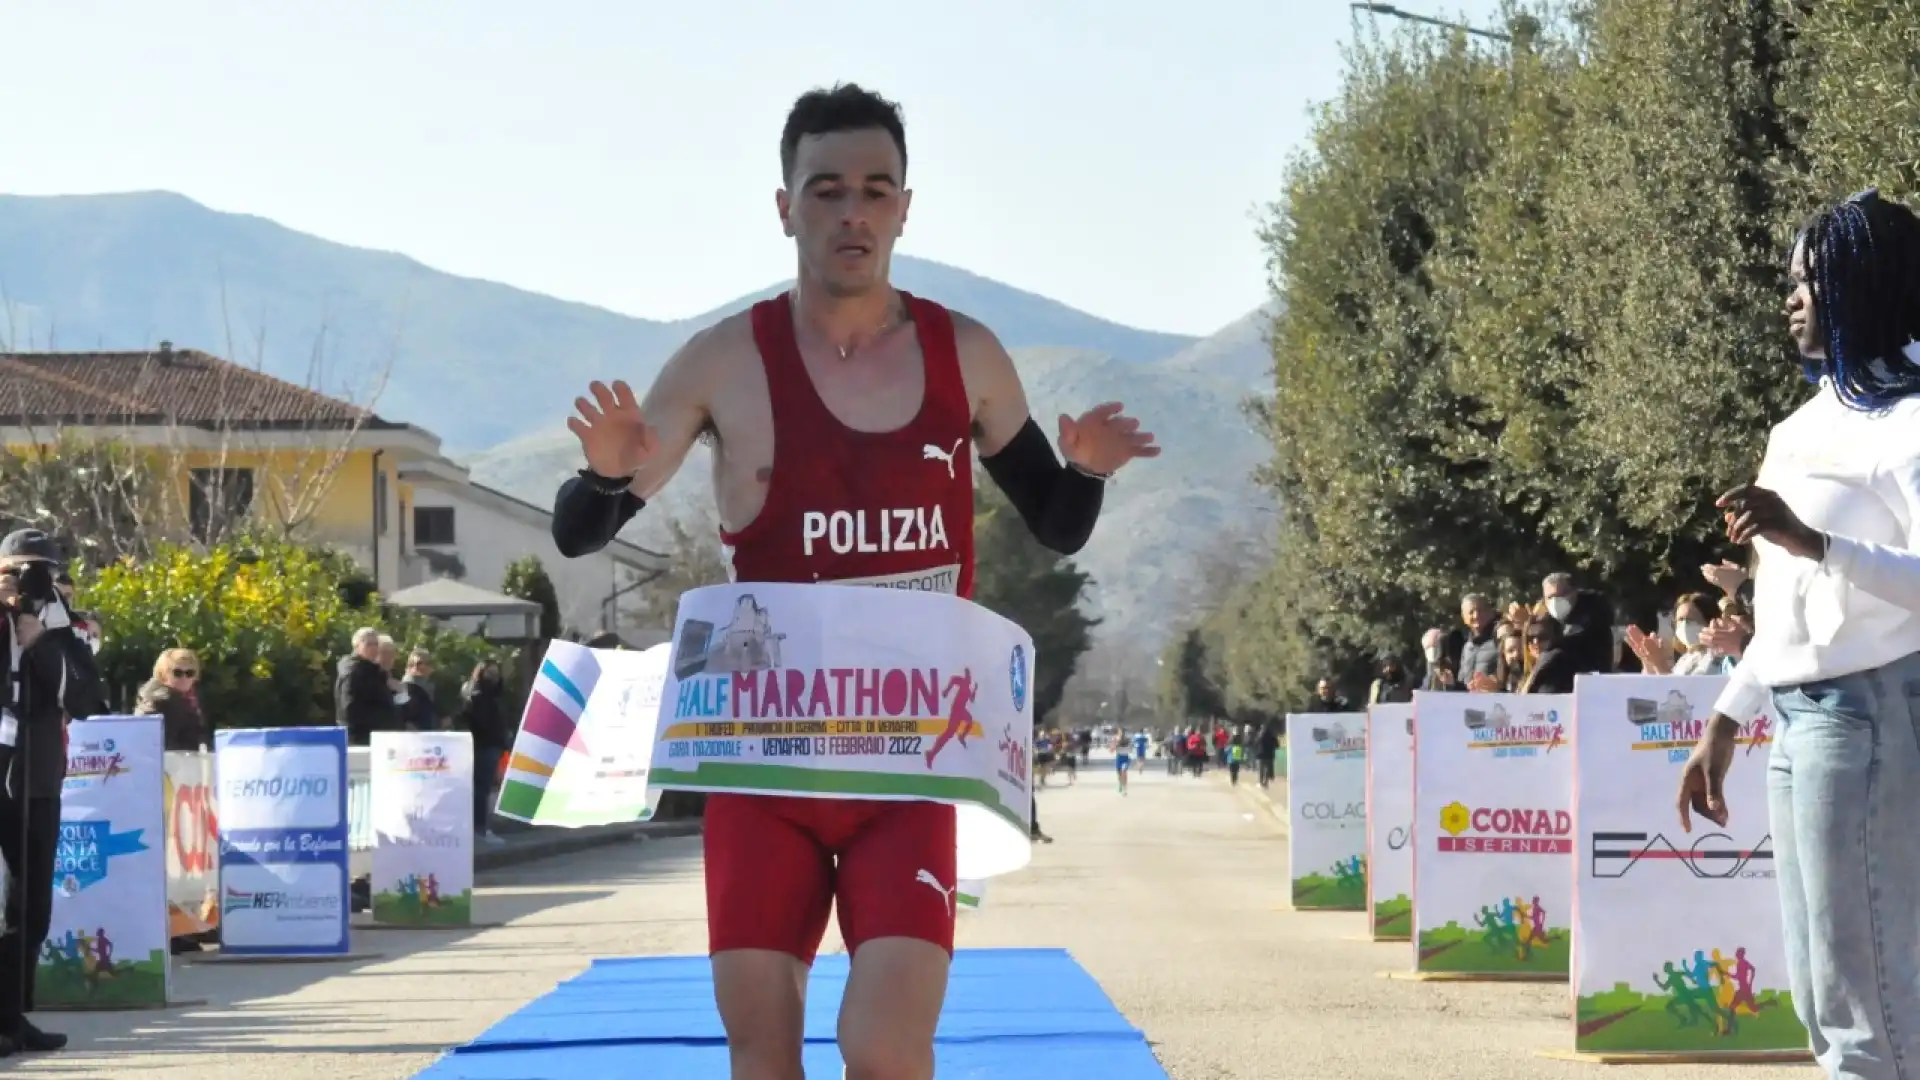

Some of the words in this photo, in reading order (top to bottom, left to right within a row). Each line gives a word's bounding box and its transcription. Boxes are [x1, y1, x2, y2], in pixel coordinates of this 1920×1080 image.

[803, 504, 949, 556] POLIZIA
[675, 678, 729, 718] HALF
[732, 668, 939, 718] MARATHON
[1641, 722, 1671, 741] HALF
[762, 737, 811, 757] VENAFRO
[814, 736, 826, 755] 13
[829, 735, 885, 756] FEBBRAIO
[888, 735, 922, 756] 2022
[1472, 807, 1572, 835] CONAD
[1452, 838, 1558, 852] ISERNIA
